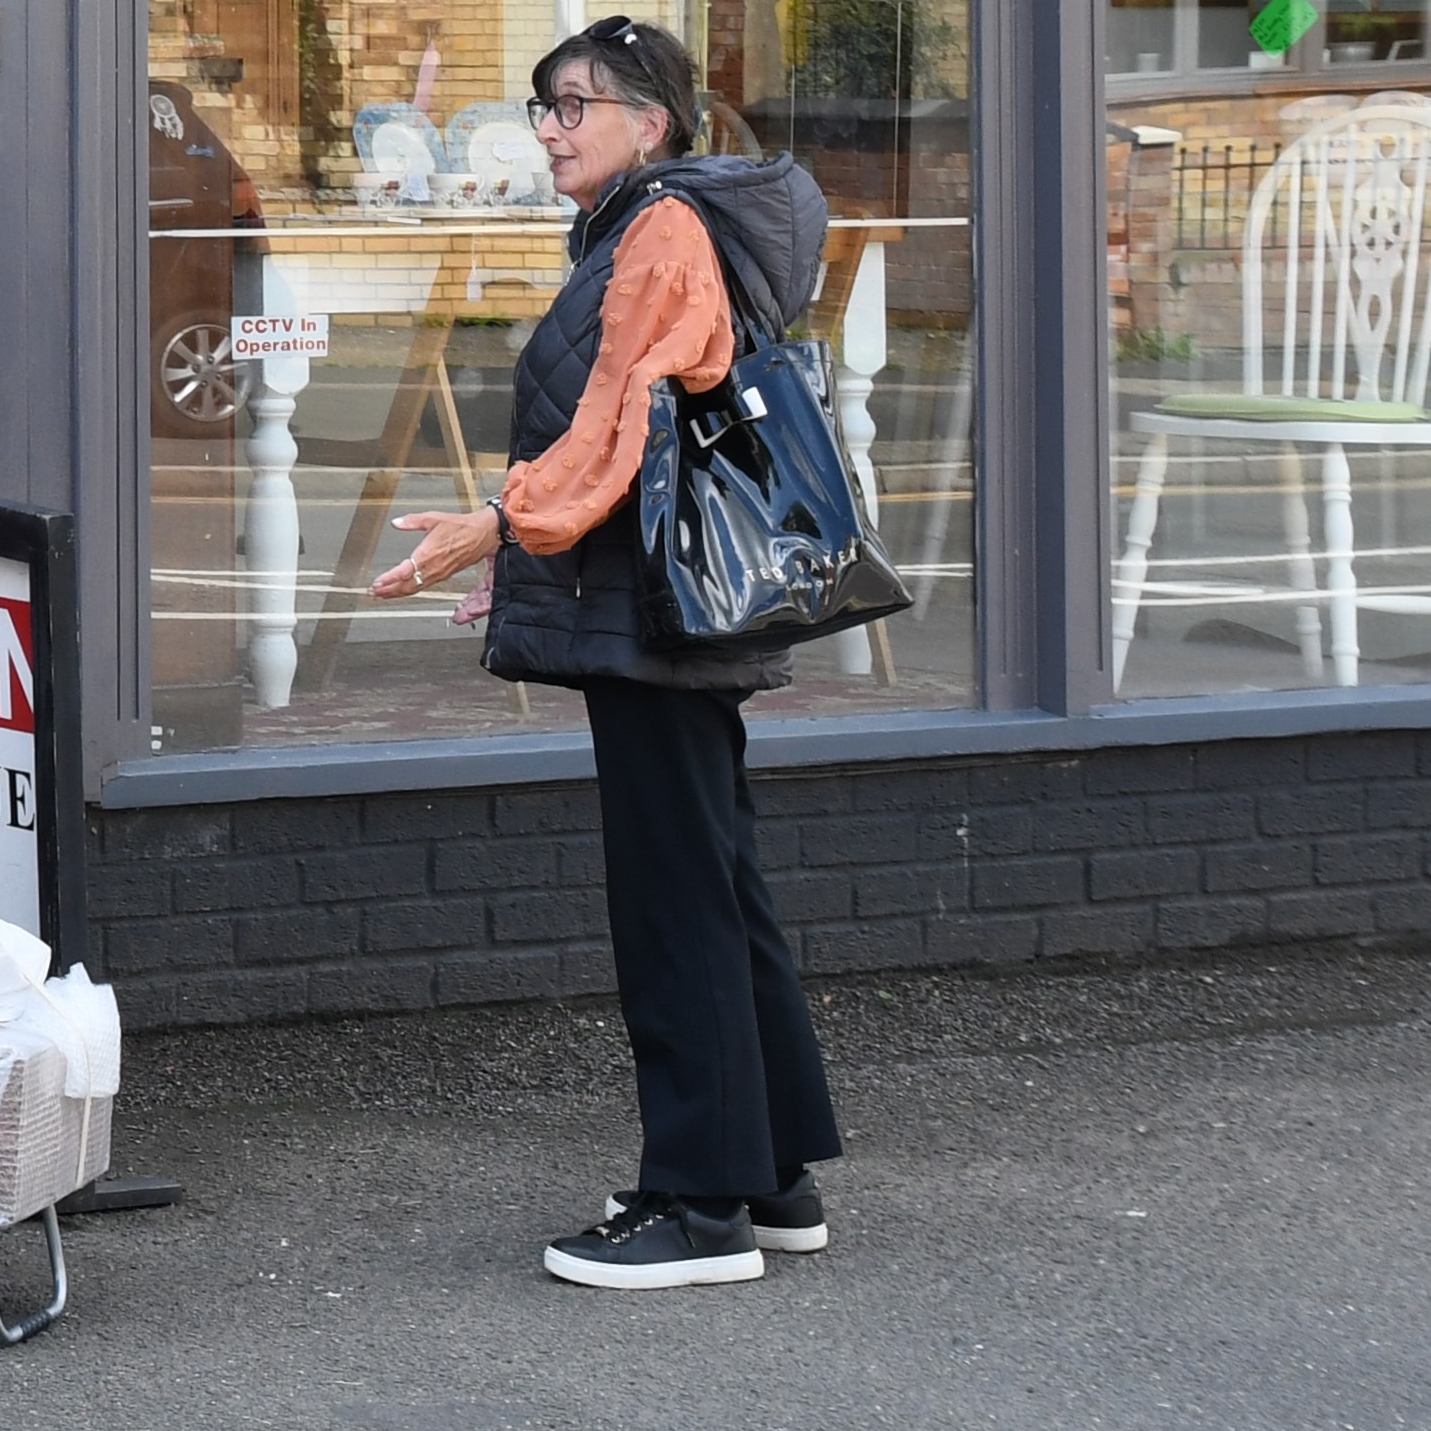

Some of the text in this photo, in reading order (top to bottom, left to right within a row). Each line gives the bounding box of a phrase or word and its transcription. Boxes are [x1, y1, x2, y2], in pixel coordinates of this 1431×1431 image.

[241, 317, 317, 334] CCTV In
[235, 337, 326, 356] Operation
[745, 547, 859, 582] TED BAKER
[786, 578, 834, 591] LONDON
